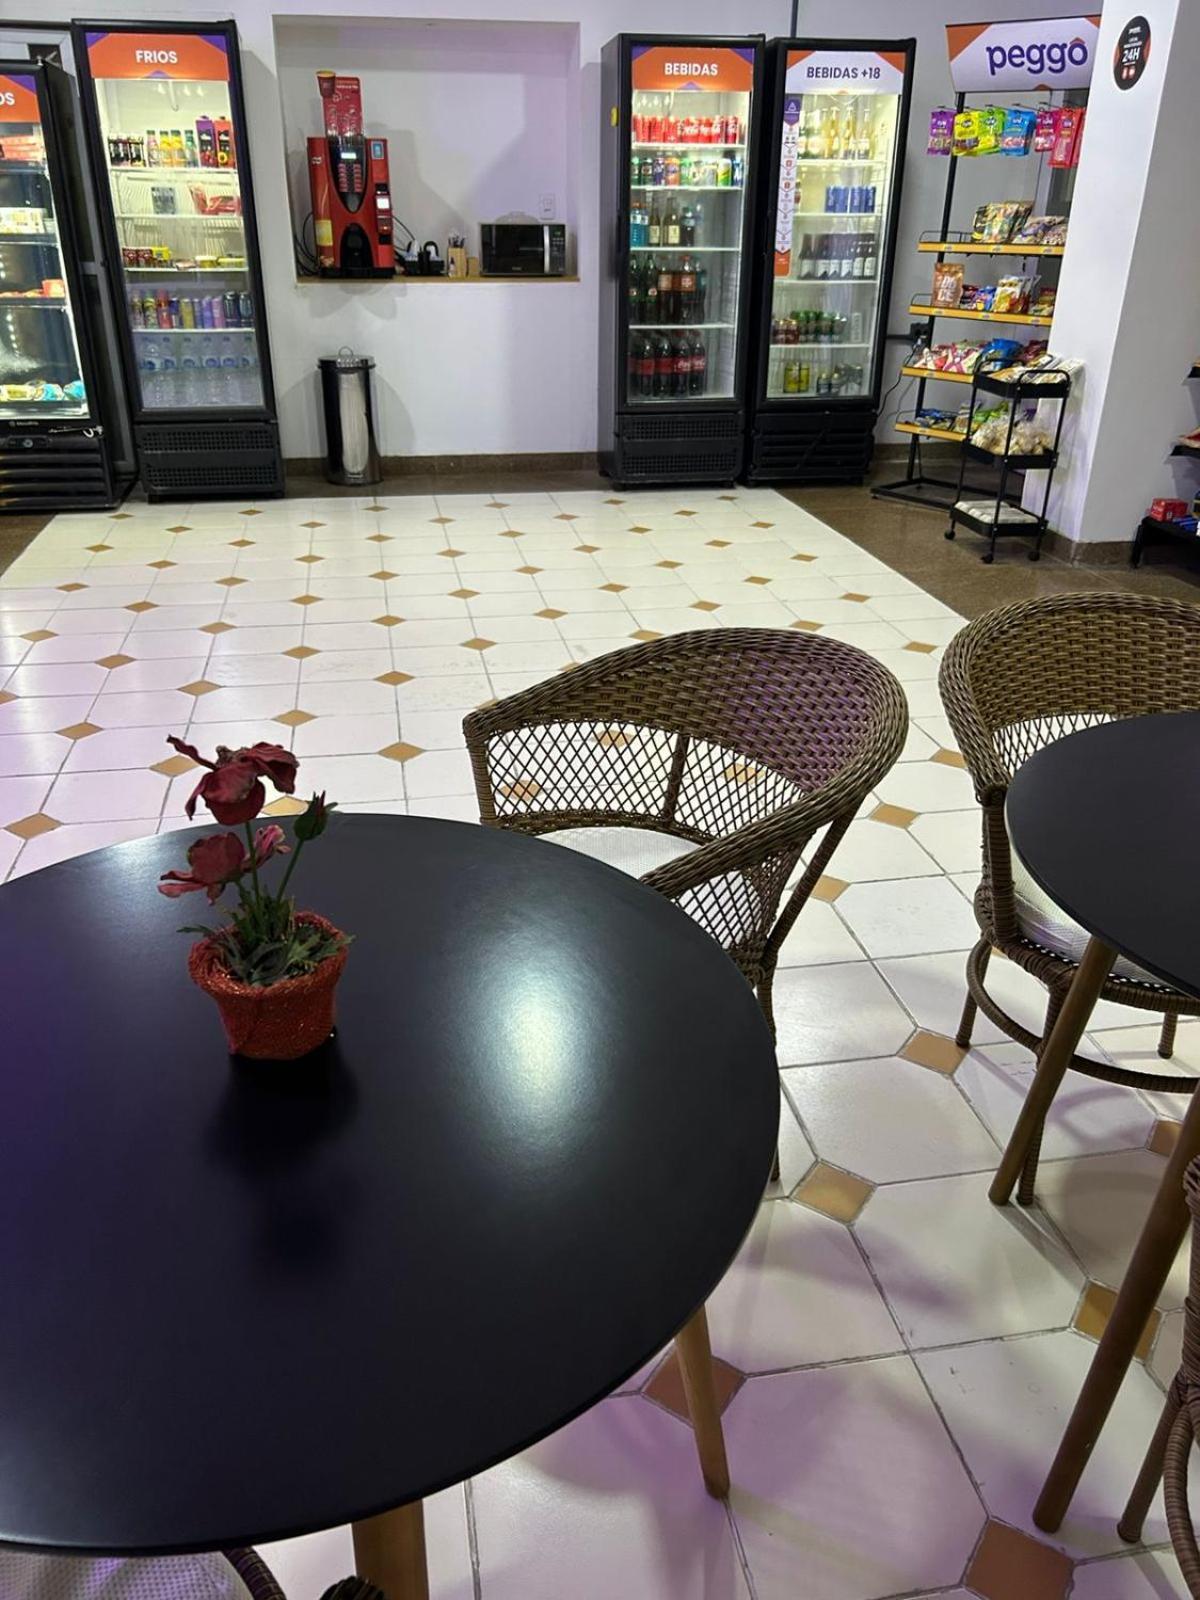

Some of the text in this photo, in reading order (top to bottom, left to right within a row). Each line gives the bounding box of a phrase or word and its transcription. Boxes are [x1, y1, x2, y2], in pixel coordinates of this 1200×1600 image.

[135, 50, 178, 64] FRIOS
[986, 37, 1088, 76] peggô
[1122, 47, 1141, 62] 24H
[664, 62, 718, 76] BEBIDAS
[806, 66, 881, 80] BEBIDAS +18
